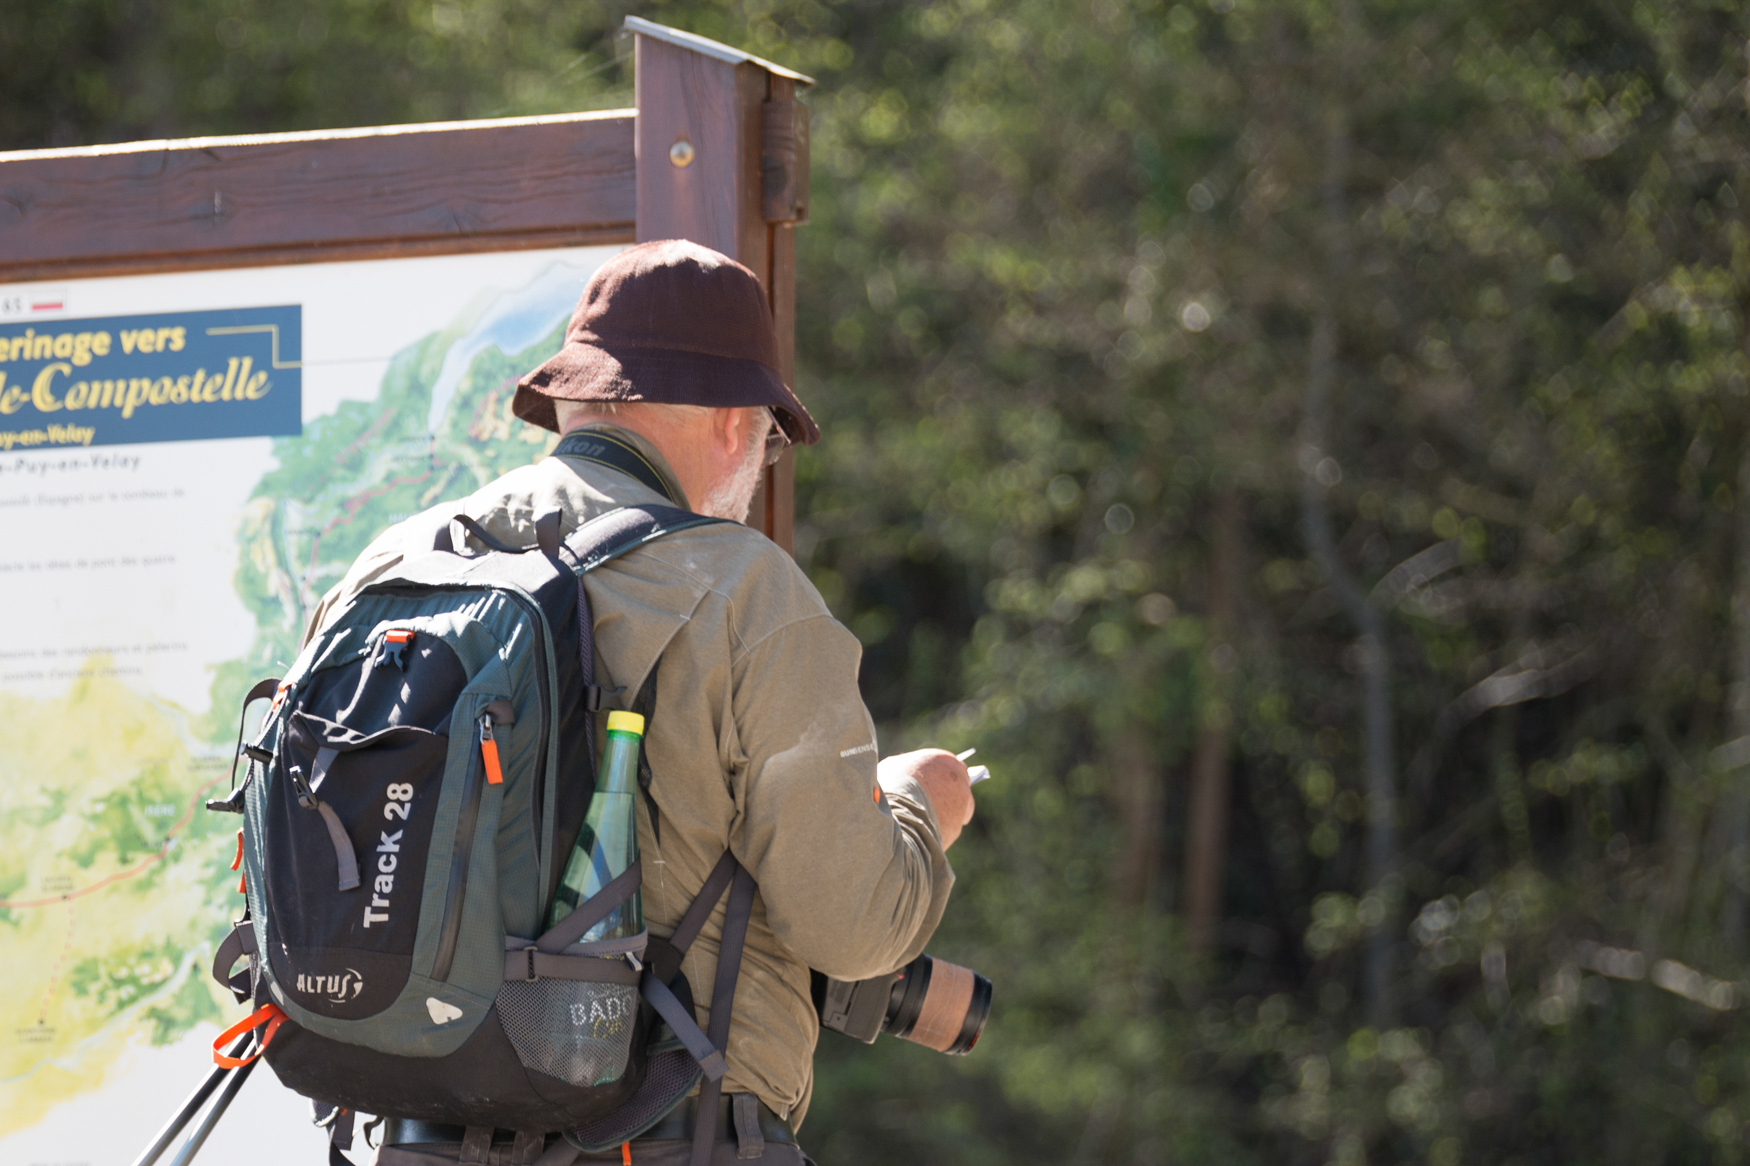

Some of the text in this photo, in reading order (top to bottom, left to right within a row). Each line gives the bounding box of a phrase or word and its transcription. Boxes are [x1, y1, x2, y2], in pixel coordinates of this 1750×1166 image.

[120, 326, 186, 354] vers
[555, 438, 606, 457] ikon
[363, 782, 414, 929] Track 28
[296, 973, 352, 999] ALTUS
